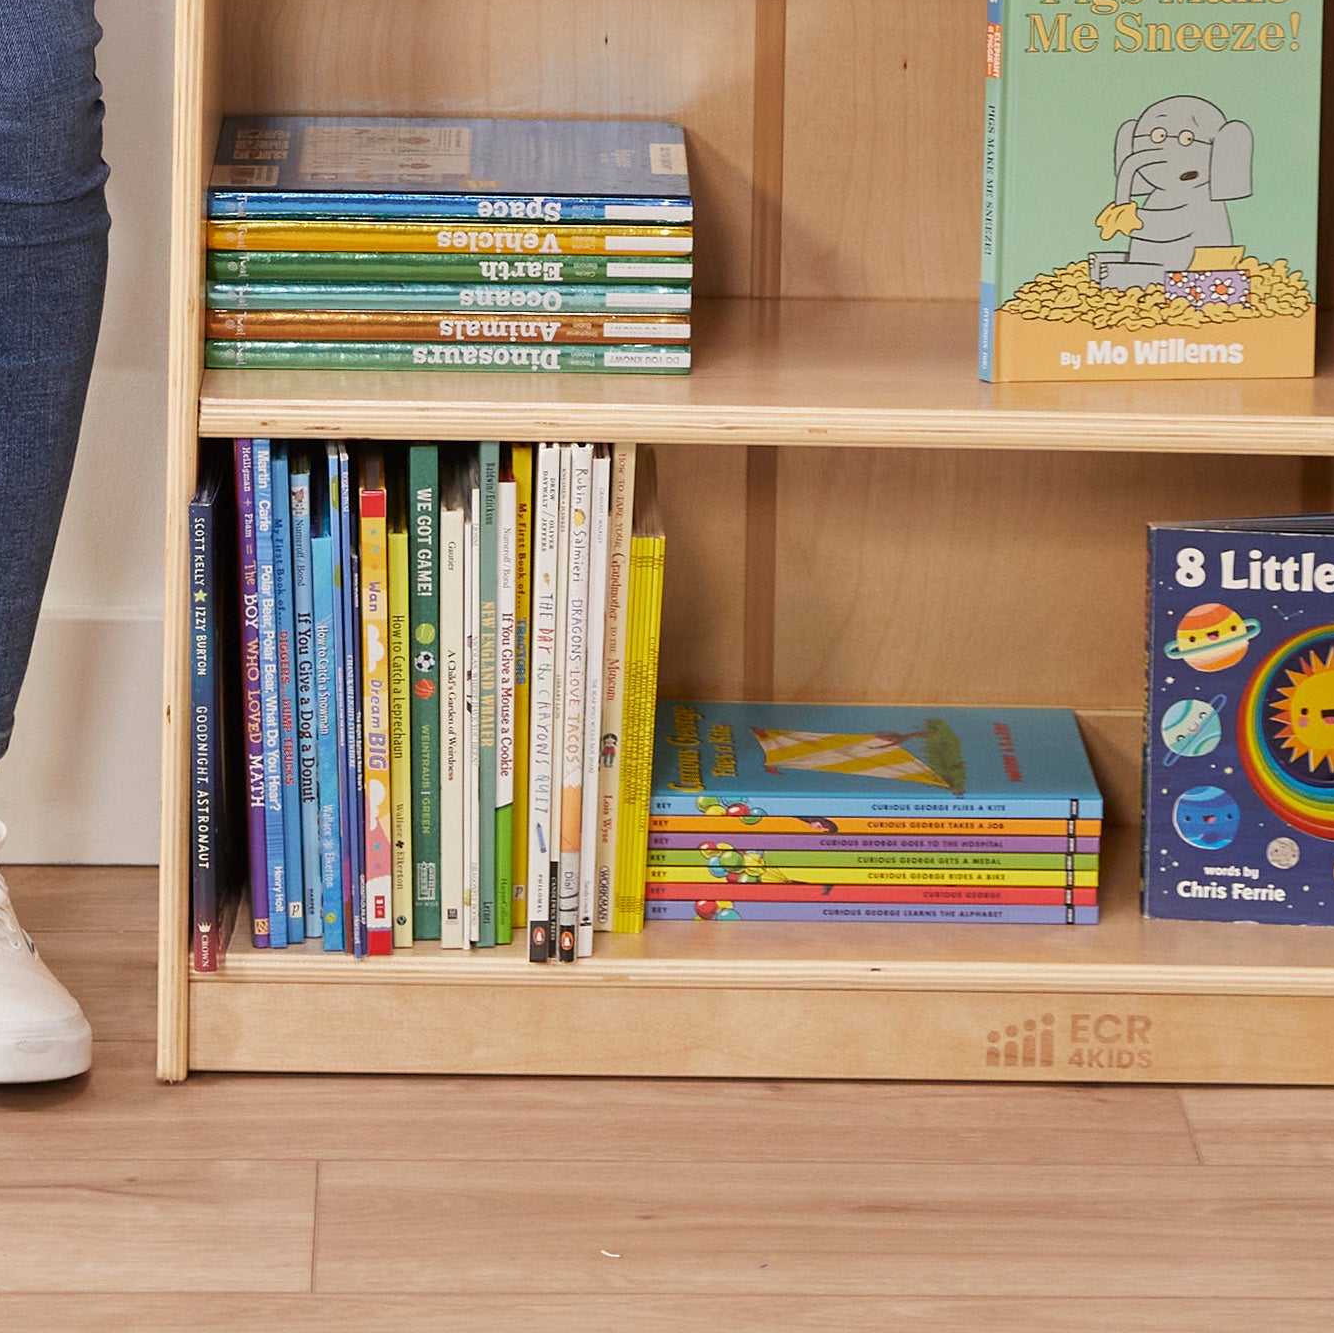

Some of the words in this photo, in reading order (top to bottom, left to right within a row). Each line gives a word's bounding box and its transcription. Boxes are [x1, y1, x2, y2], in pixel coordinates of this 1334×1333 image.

[1025, 13, 1099, 53] Me
[1114, 12, 1301, 53] Sneeze!
[477, 199, 562, 222] Space
[436, 230, 563, 254] Vehicles
[480, 260, 564, 281] Earth
[459, 289, 563, 311] Oceans
[439, 319, 562, 342] Animals
[413, 346, 562, 371] Dinosaurs
[1060, 350, 1081, 369] By
[1087, 340, 1128, 364] Mo
[1133, 339, 1244, 364] Willems
[257, 450, 270, 489] Martin
[417, 487, 432, 512] WE
[574, 468, 588, 504] Rubin
[258, 500, 271, 532] Carle
[417, 515, 432, 545] GOT
[194, 517, 205, 552] SCOTT
[194, 555, 205, 586] KELLY
[572, 531, 587, 582] Salmieri
[1175, 547, 1205, 587] 8
[244, 560, 256, 586] The
[260, 565, 273, 594] Polar
[417, 549, 433, 596] GAME!
[244, 593, 259, 630] BOY
[369, 581, 381, 612] Wan
[539, 594, 554, 620] THE
[195, 607, 206, 631] IZZY
[298, 612, 310, 624] If
[392, 615, 405, 638] How
[482, 601, 495, 627] NEW
[502, 613, 513, 622] If
[298, 626, 312, 656] You
[317, 625, 329, 649] How
[502, 623, 513, 644] You
[538, 628, 554, 655] DAY
[569, 599, 583, 662] DRAGONS
[196, 635, 207, 675] BURTON
[246, 638, 260, 682] WHO
[263, 632, 276, 662] Polar
[392, 641, 403, 653] to
[447, 649, 456, 658] A
[481, 633, 495, 690] ENGLAND
[502, 649, 513, 674] Give
[299, 660, 313, 692] Give
[318, 659, 330, 682] Catch
[392, 656, 405, 684] Catch
[447, 660, 457, 689] Child's
[537, 663, 552, 680] the
[300, 697, 310, 706] a
[569, 669, 581, 706] LOVE
[247, 689, 263, 743] LOVED
[265, 696, 279, 727] What
[318, 692, 331, 735] Snowman
[369, 679, 383, 729] Dream
[447, 692, 457, 724] Garden
[501, 687, 513, 724] Mouse
[300, 710, 314, 738] Dog
[392, 697, 406, 759] Leprechaun
[448, 726, 457, 735] of
[481, 694, 495, 747] WHALER
[535, 689, 552, 766] CRAYONS
[266, 730, 277, 748] Do
[302, 743, 311, 752] a
[368, 732, 387, 772] BIG
[566, 714, 582, 763] TACOS
[266, 750, 280, 774] You
[421, 724, 430, 788] WEINTRAUB
[447, 736, 457, 781] Weirdness
[500, 737, 513, 777] Cookie
[249, 754, 265, 807] MATH
[267, 775, 282, 811] Hear?
[301, 757, 316, 803] Donut
[534, 774, 550, 814] QUIT
[421, 798, 431, 834] GREEN
[603, 794, 613, 816] Lois
[197, 790, 210, 869] ASTRONAUT
[601, 818, 612, 844] Wyse
[273, 865, 284, 895] Henry
[564, 871, 574, 890] Dial
[1203, 865, 1239, 878] words
[1242, 865, 1260, 880] by
[275, 896, 285, 913] Holt
[1176, 880, 1229, 901] Chris
[1231, 882, 1286, 902] Ferrie
[201, 934, 210, 967] CROWN
[1071, 1014, 1153, 1044] ECR
[1069, 1047, 1153, 1069] 4KIDS
